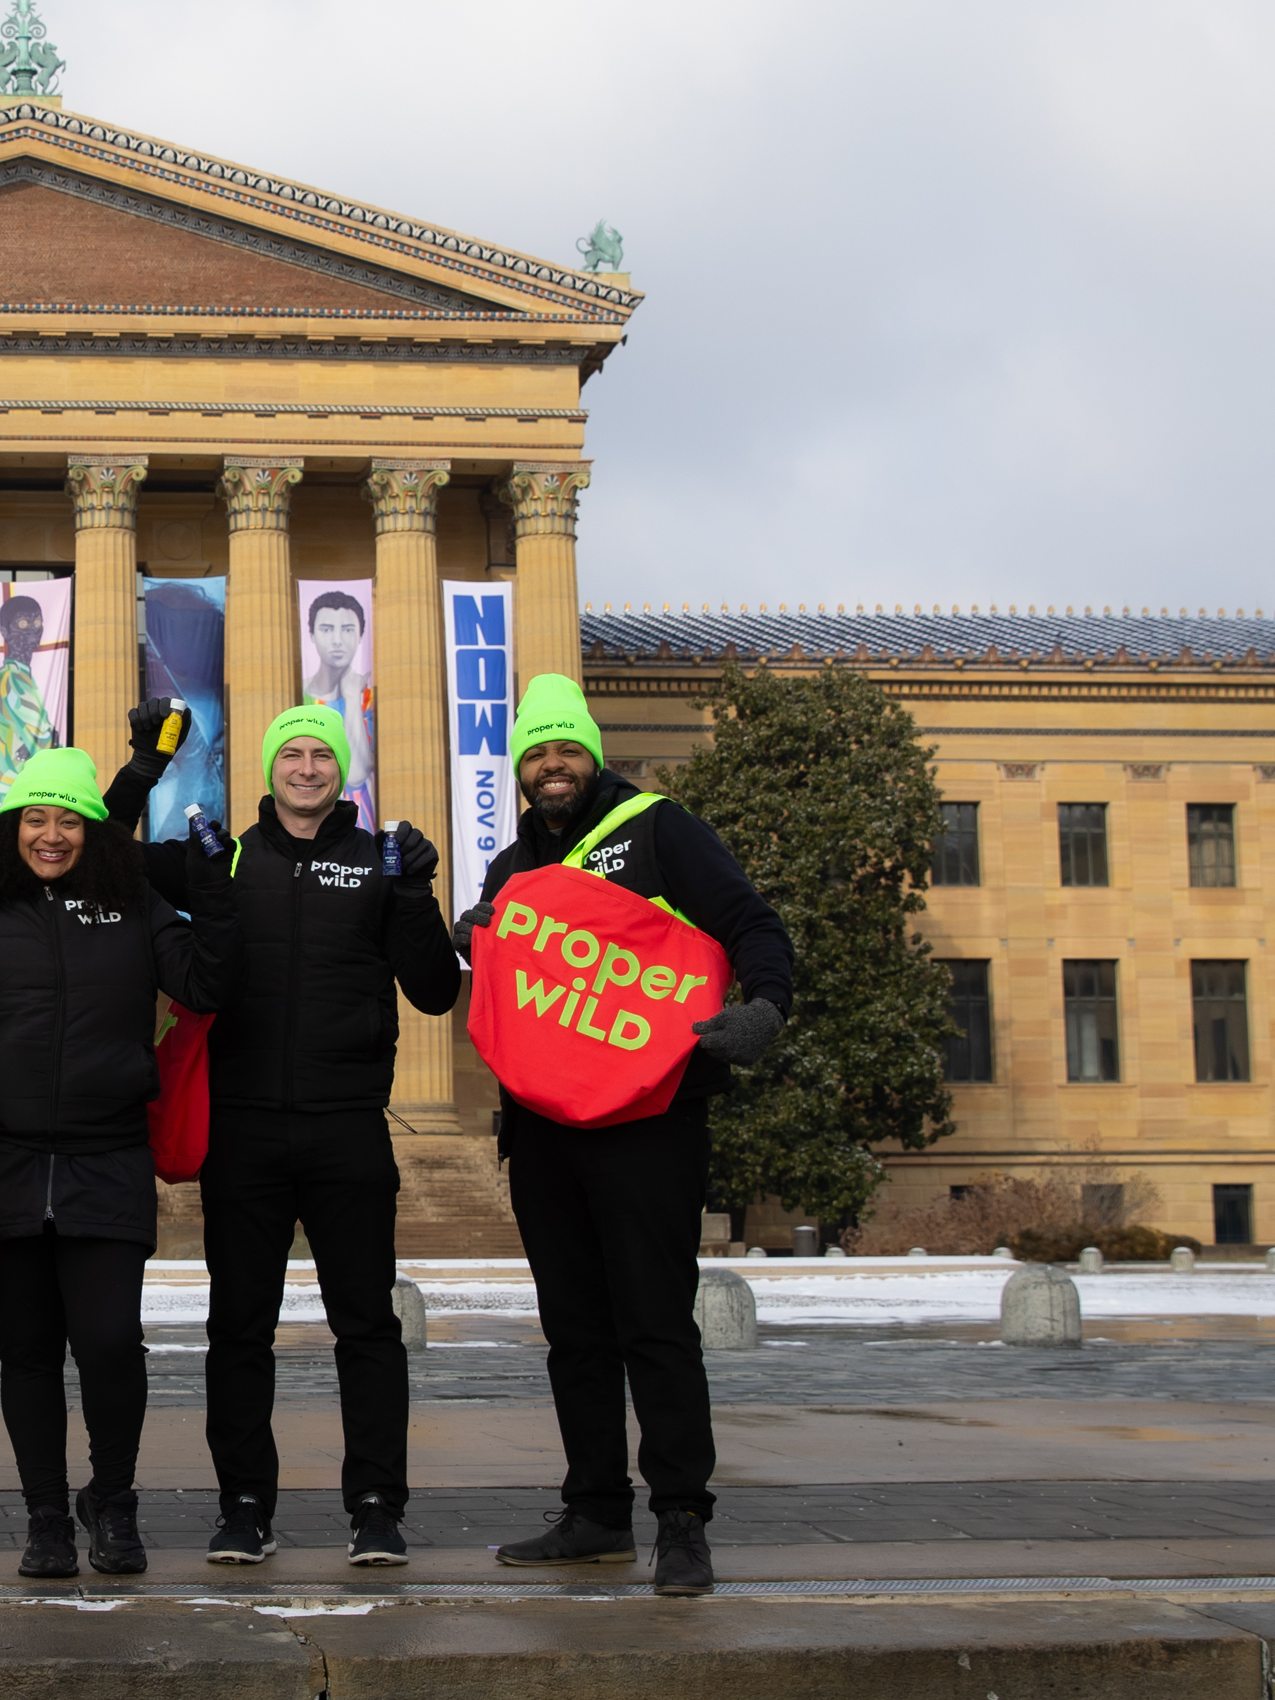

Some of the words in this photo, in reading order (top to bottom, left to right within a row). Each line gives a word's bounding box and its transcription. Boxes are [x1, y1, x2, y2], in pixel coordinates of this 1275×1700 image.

[453, 594, 507, 756] NOW
[476, 770, 496, 829] NOV
[477, 836, 496, 851] 9
